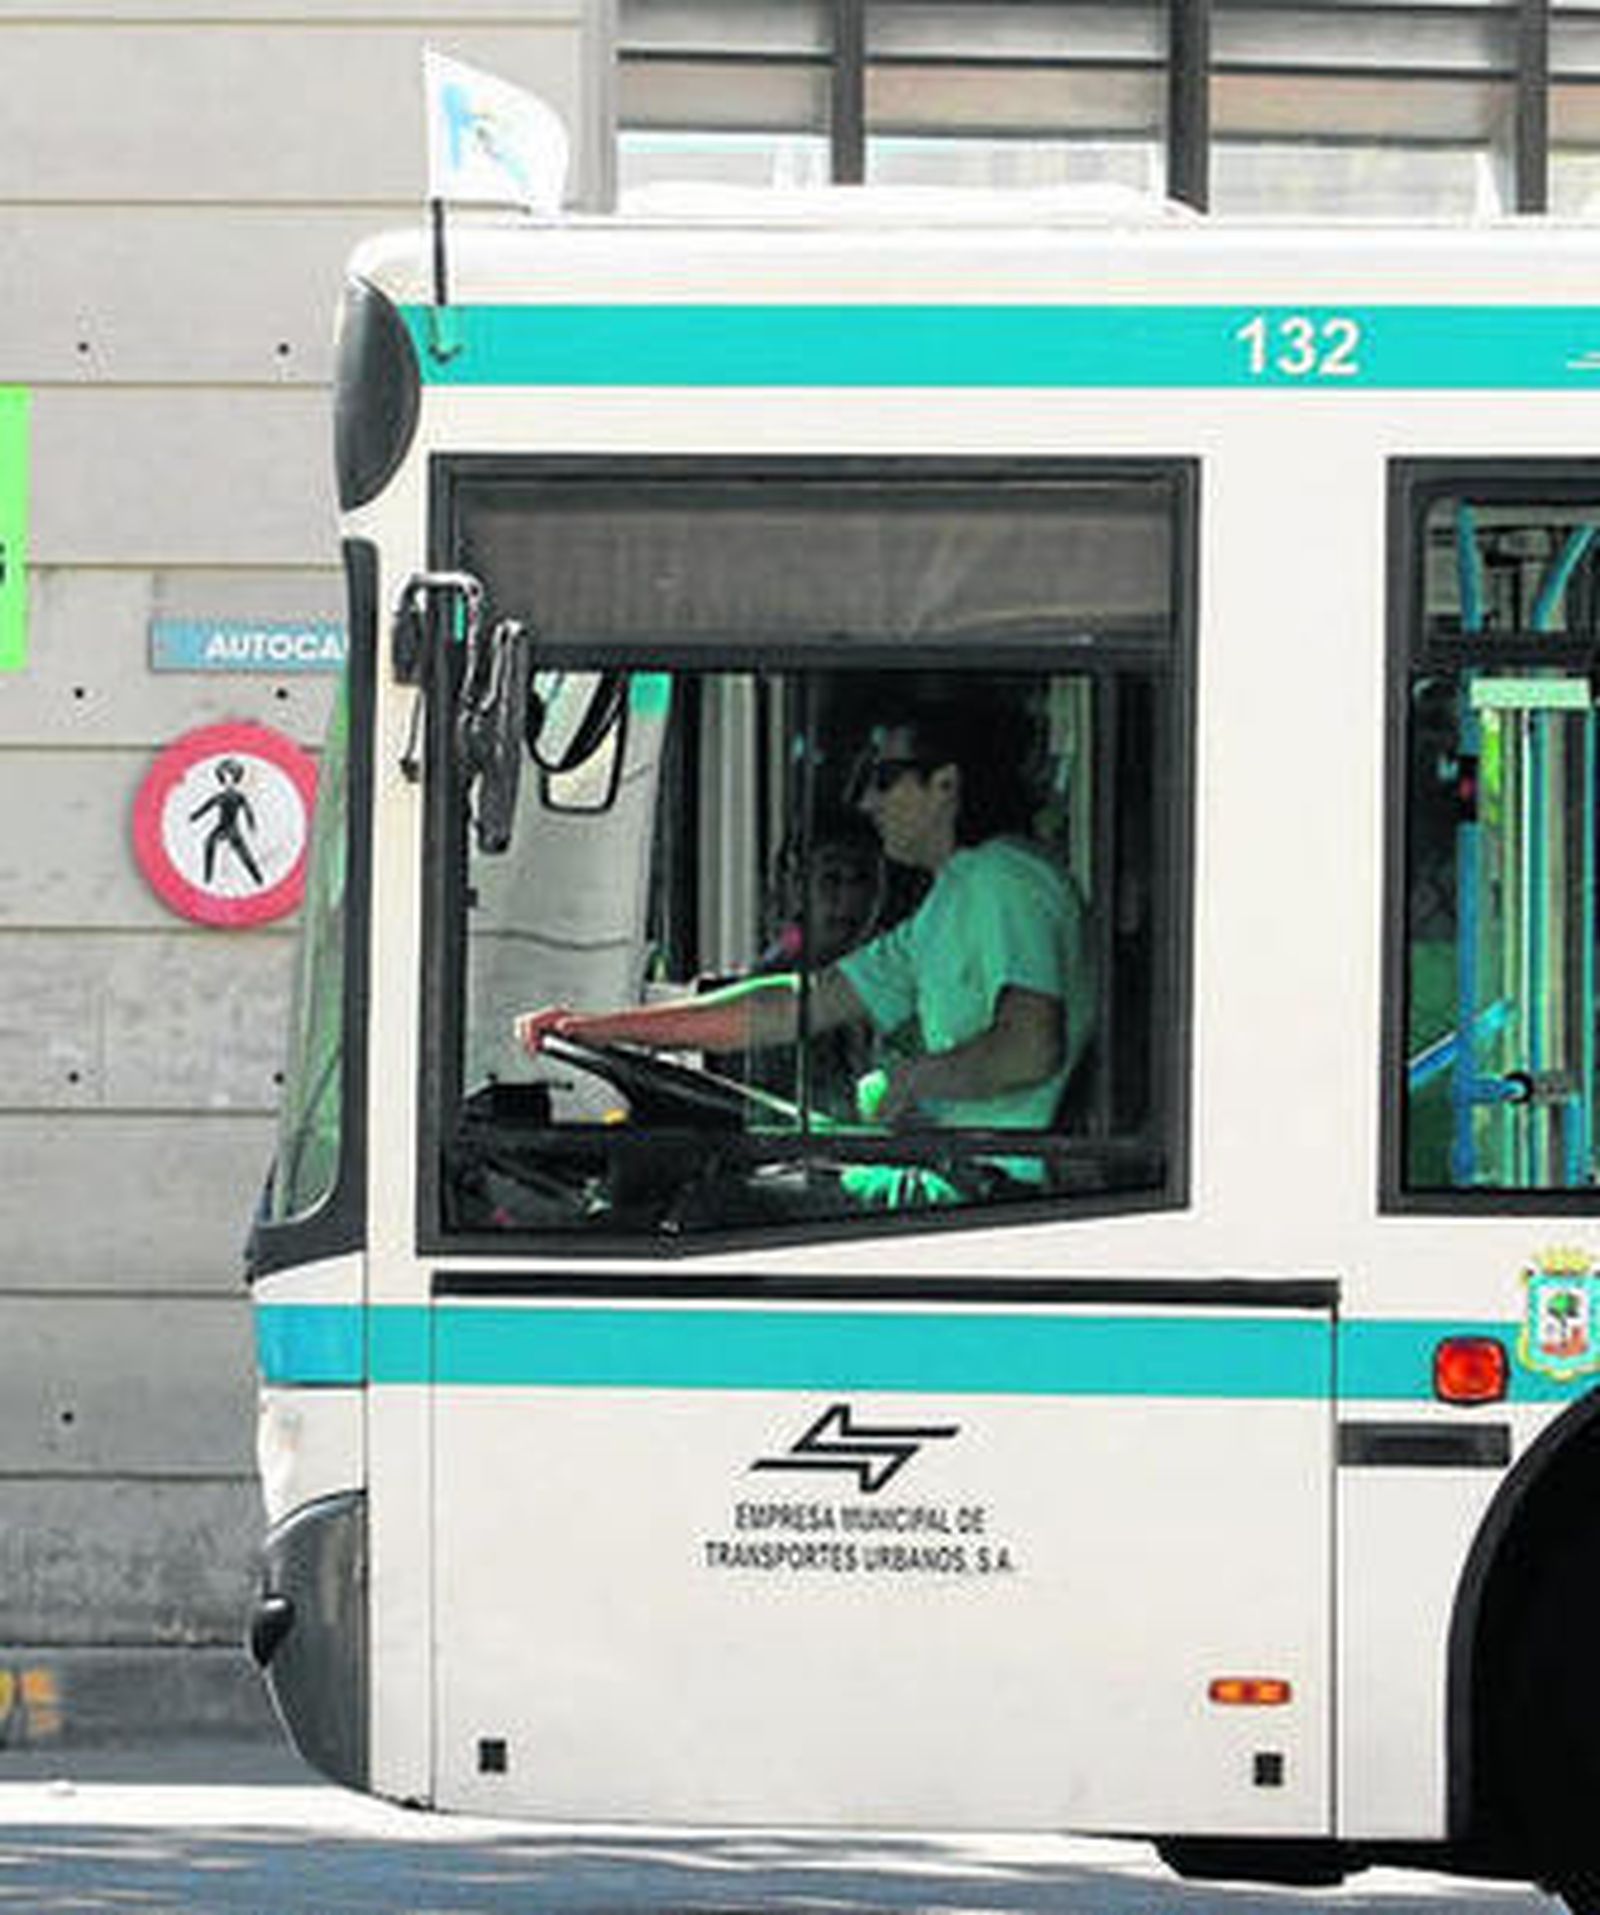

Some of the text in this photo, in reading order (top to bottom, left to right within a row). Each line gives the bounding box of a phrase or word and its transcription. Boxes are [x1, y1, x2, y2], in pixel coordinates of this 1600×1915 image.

[1236, 316, 1360, 375] 132
[204, 632, 349, 660] AUTOCA
[735, 1504, 985, 1534] EMPRESA MUNICIPAL DE
[705, 1541, 858, 1572] TRANSPORTES
